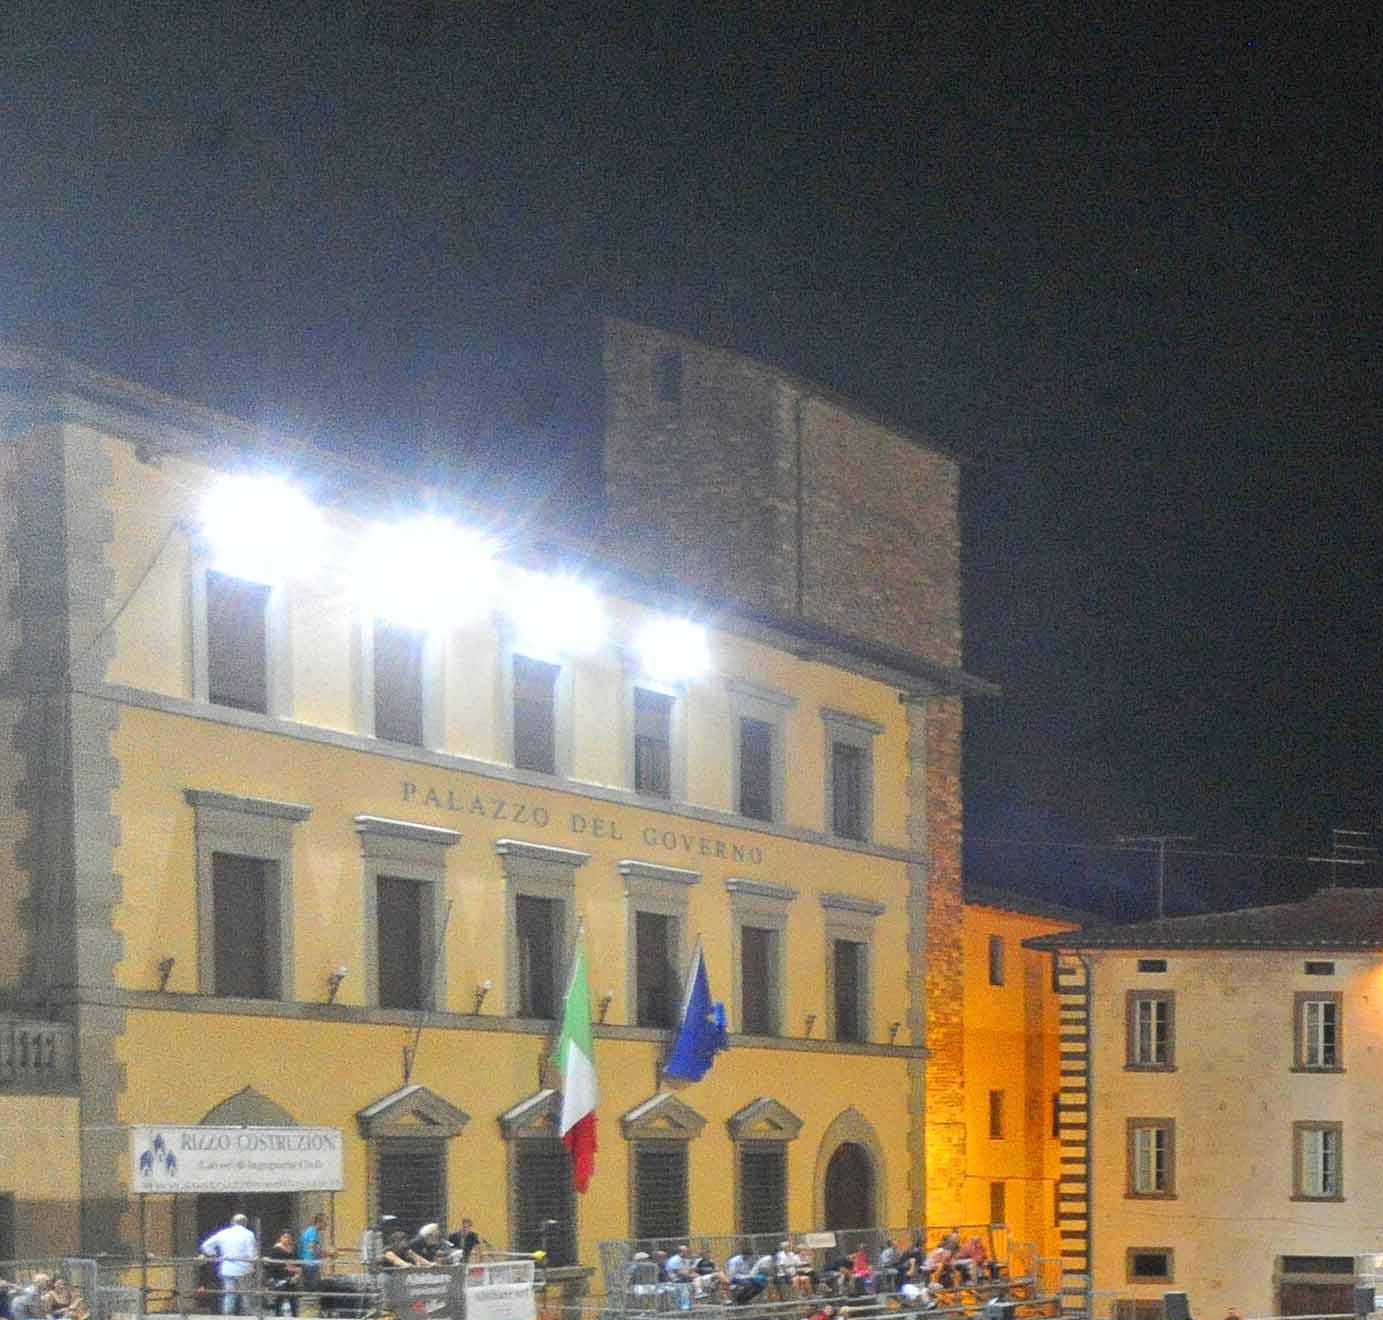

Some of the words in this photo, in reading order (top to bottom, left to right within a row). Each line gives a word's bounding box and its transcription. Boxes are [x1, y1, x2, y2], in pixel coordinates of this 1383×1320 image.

[403, 782, 549, 828] PALAZZO
[569, 813, 624, 840] DEL
[642, 827, 763, 866] GOVERNO
[180, 1132, 231, 1151] RIZZO
